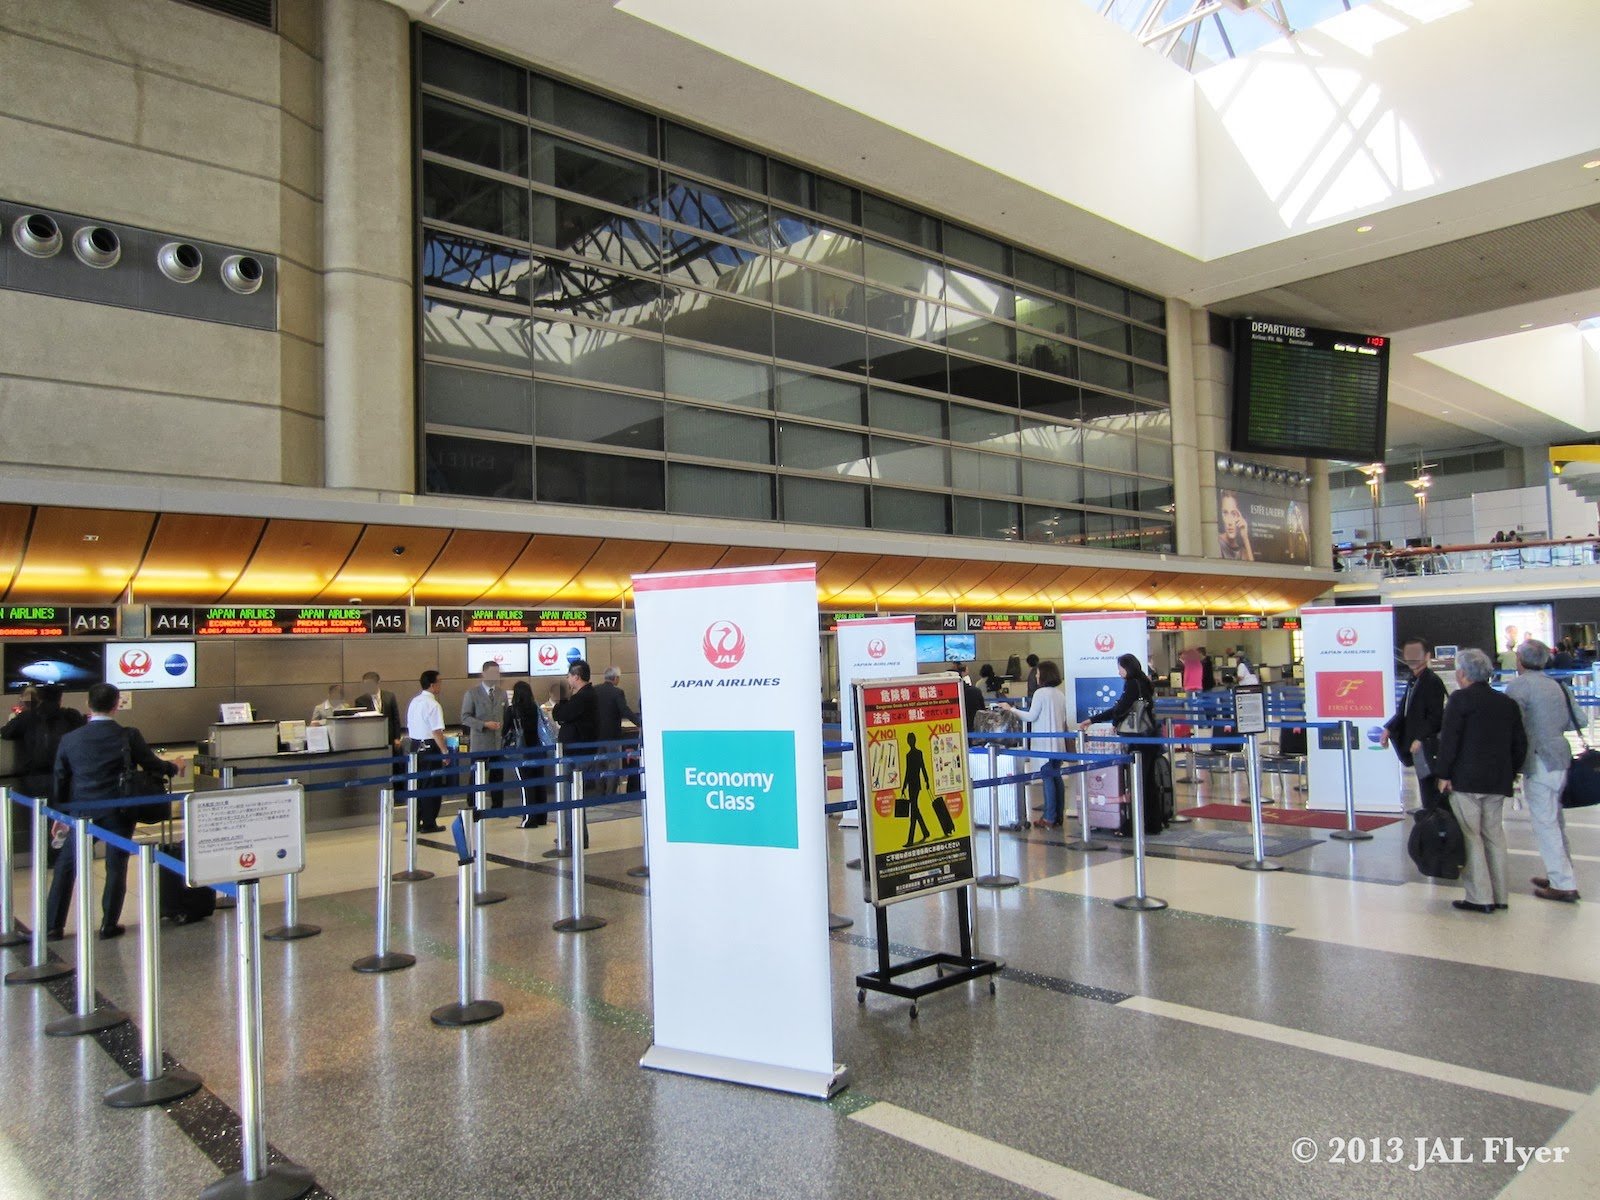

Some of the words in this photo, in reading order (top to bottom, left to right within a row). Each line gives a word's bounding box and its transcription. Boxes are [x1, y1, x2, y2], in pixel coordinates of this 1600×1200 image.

[1251, 322, 1306, 338] DEPARTURES
[10, 607, 55, 619] AIRLINES
[207, 608, 235, 619] JAPAN
[240, 608, 276, 619] AIRLINES
[298, 608, 325, 619] JAPAN
[328, 608, 361, 619] AIRLINES
[472, 610, 493, 620] JAPAN
[496, 610, 523, 620] AIRLINES
[540, 611, 560, 620] JAPAN
[562, 611, 587, 620] AIRLINES
[75, 615, 110, 629] A13
[157, 614, 189, 628] A14
[375, 615, 402, 628] A15
[435, 615, 460, 628] A16
[597, 616, 618, 628] A17
[944, 618, 956, 628] A21
[969, 618, 981, 627] A22
[1044, 619, 1055, 627] A23
[714, 654, 738, 664] JAL
[671, 679, 714, 689] JAPAN
[716, 677, 781, 687] AIRLINES
[938, 723, 954, 733] NO!
[880, 729, 897, 740] NO!
[684, 767, 775, 793] Economy
[705, 790, 756, 811] Class
